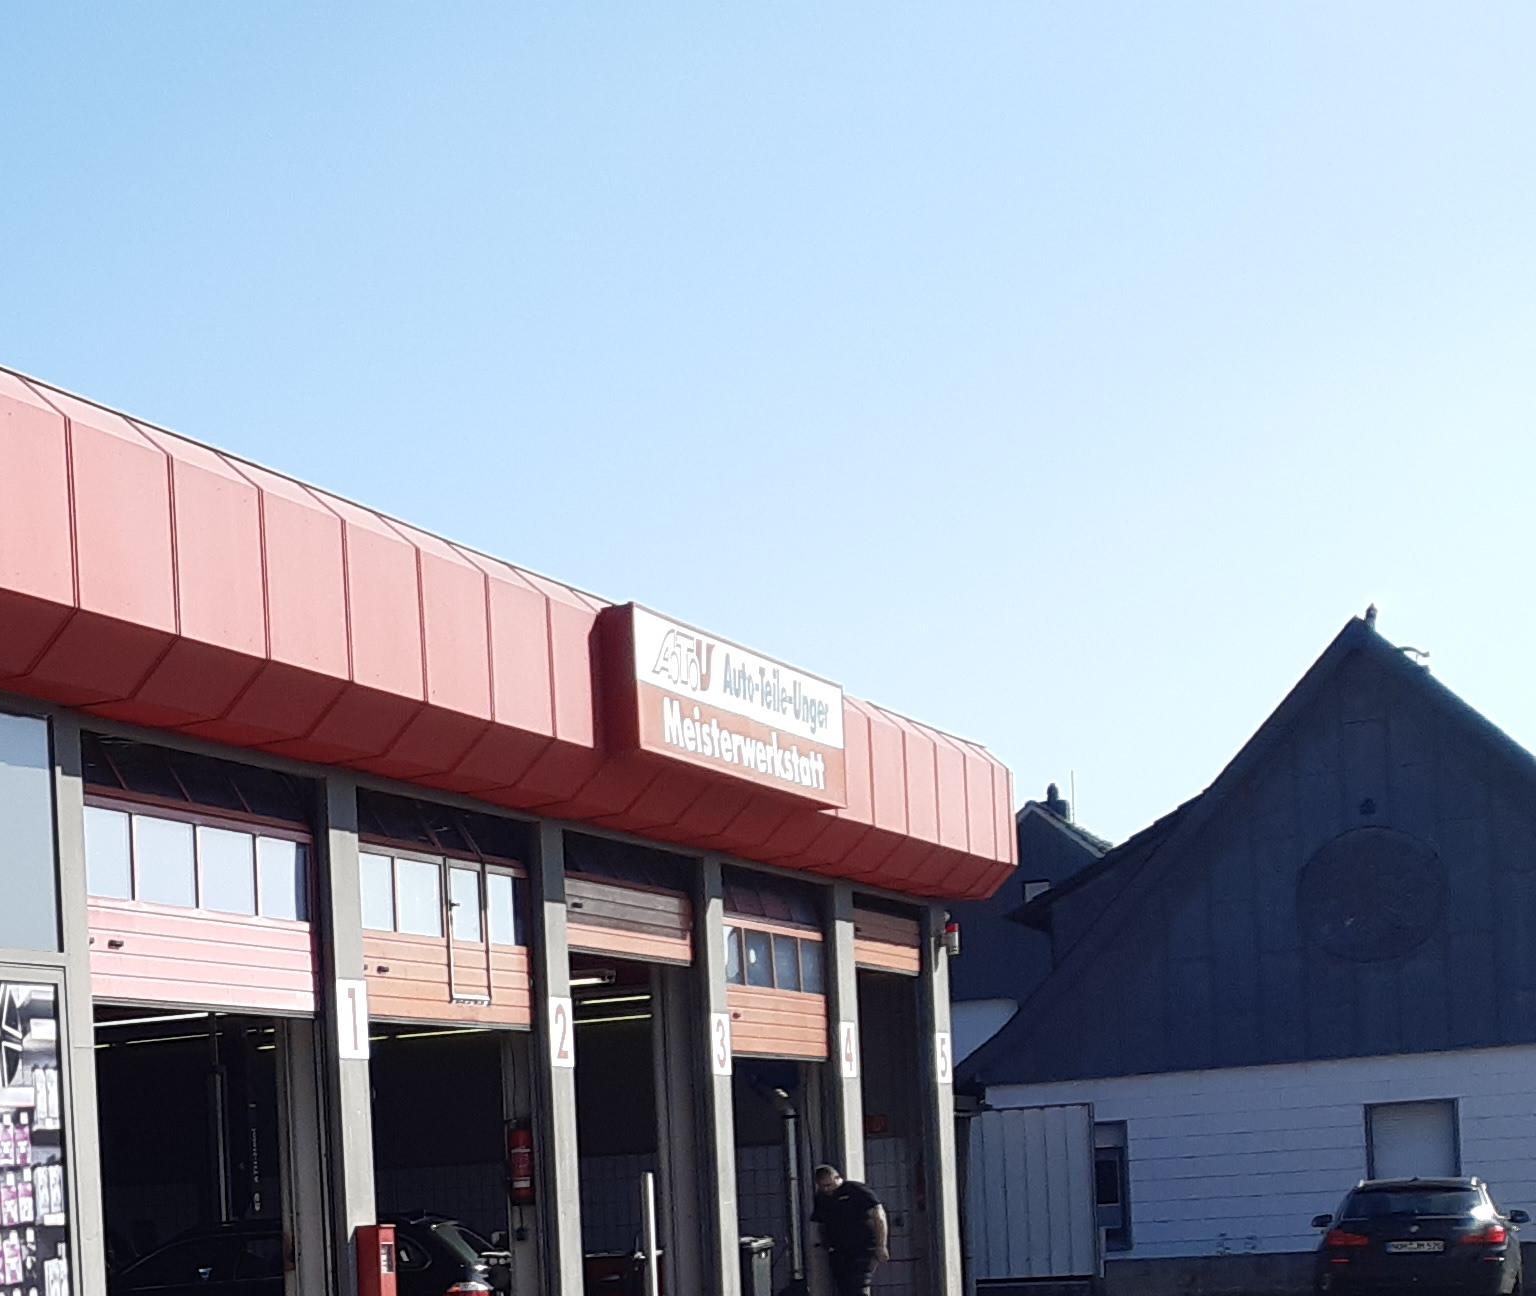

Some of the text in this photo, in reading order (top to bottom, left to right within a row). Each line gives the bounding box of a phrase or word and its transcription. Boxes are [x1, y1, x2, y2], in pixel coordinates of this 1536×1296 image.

[722, 652, 829, 734] Auto-Teile-Unger
[662, 696, 826, 790] Meisterwerkstatt
[347, 987, 359, 1051] 1
[554, 1003, 569, 1060] 2
[715, 1018, 727, 1069] 3
[843, 1027, 854, 1072] 4
[938, 1037, 948, 1078] 5
